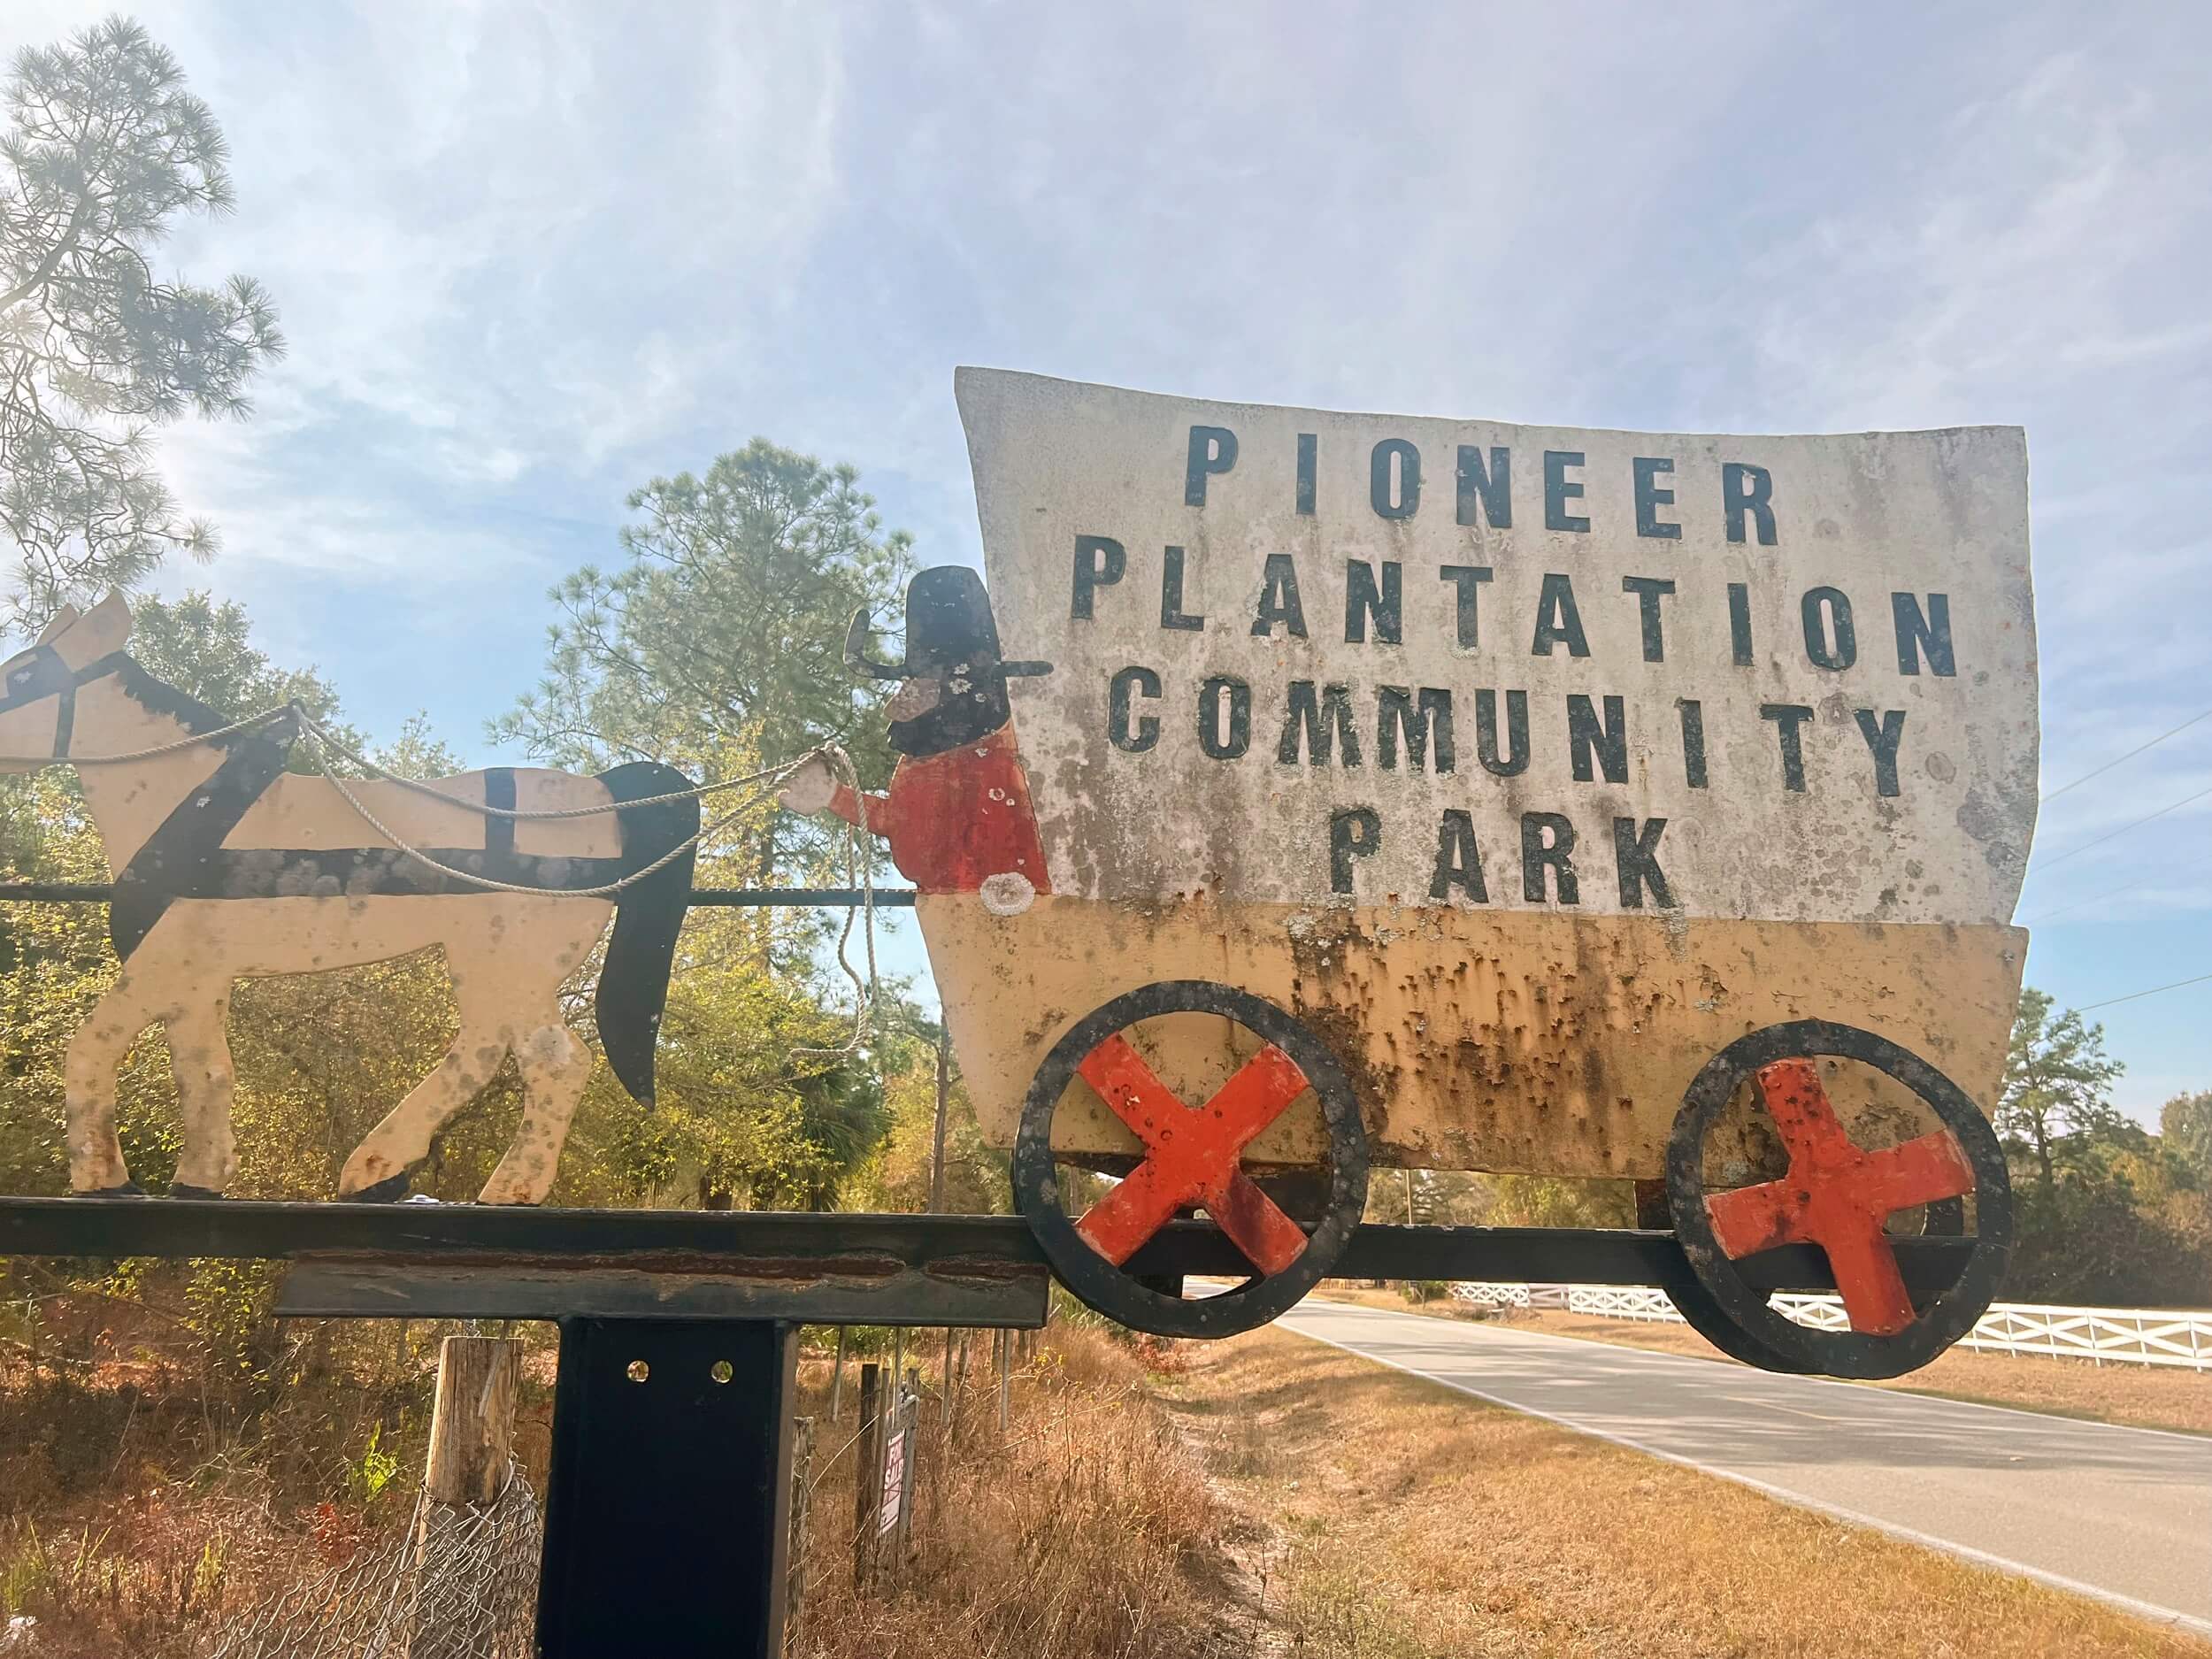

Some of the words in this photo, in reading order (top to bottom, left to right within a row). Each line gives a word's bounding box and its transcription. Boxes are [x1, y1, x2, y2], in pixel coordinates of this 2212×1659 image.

[1186, 426, 1778, 546] PIONEER
[1071, 536, 1957, 677] PLANTATION
[1109, 665, 1907, 797] COMMUNITY
[1331, 806, 1678, 909] PARK
[884, 1458, 903, 1490] SALE
